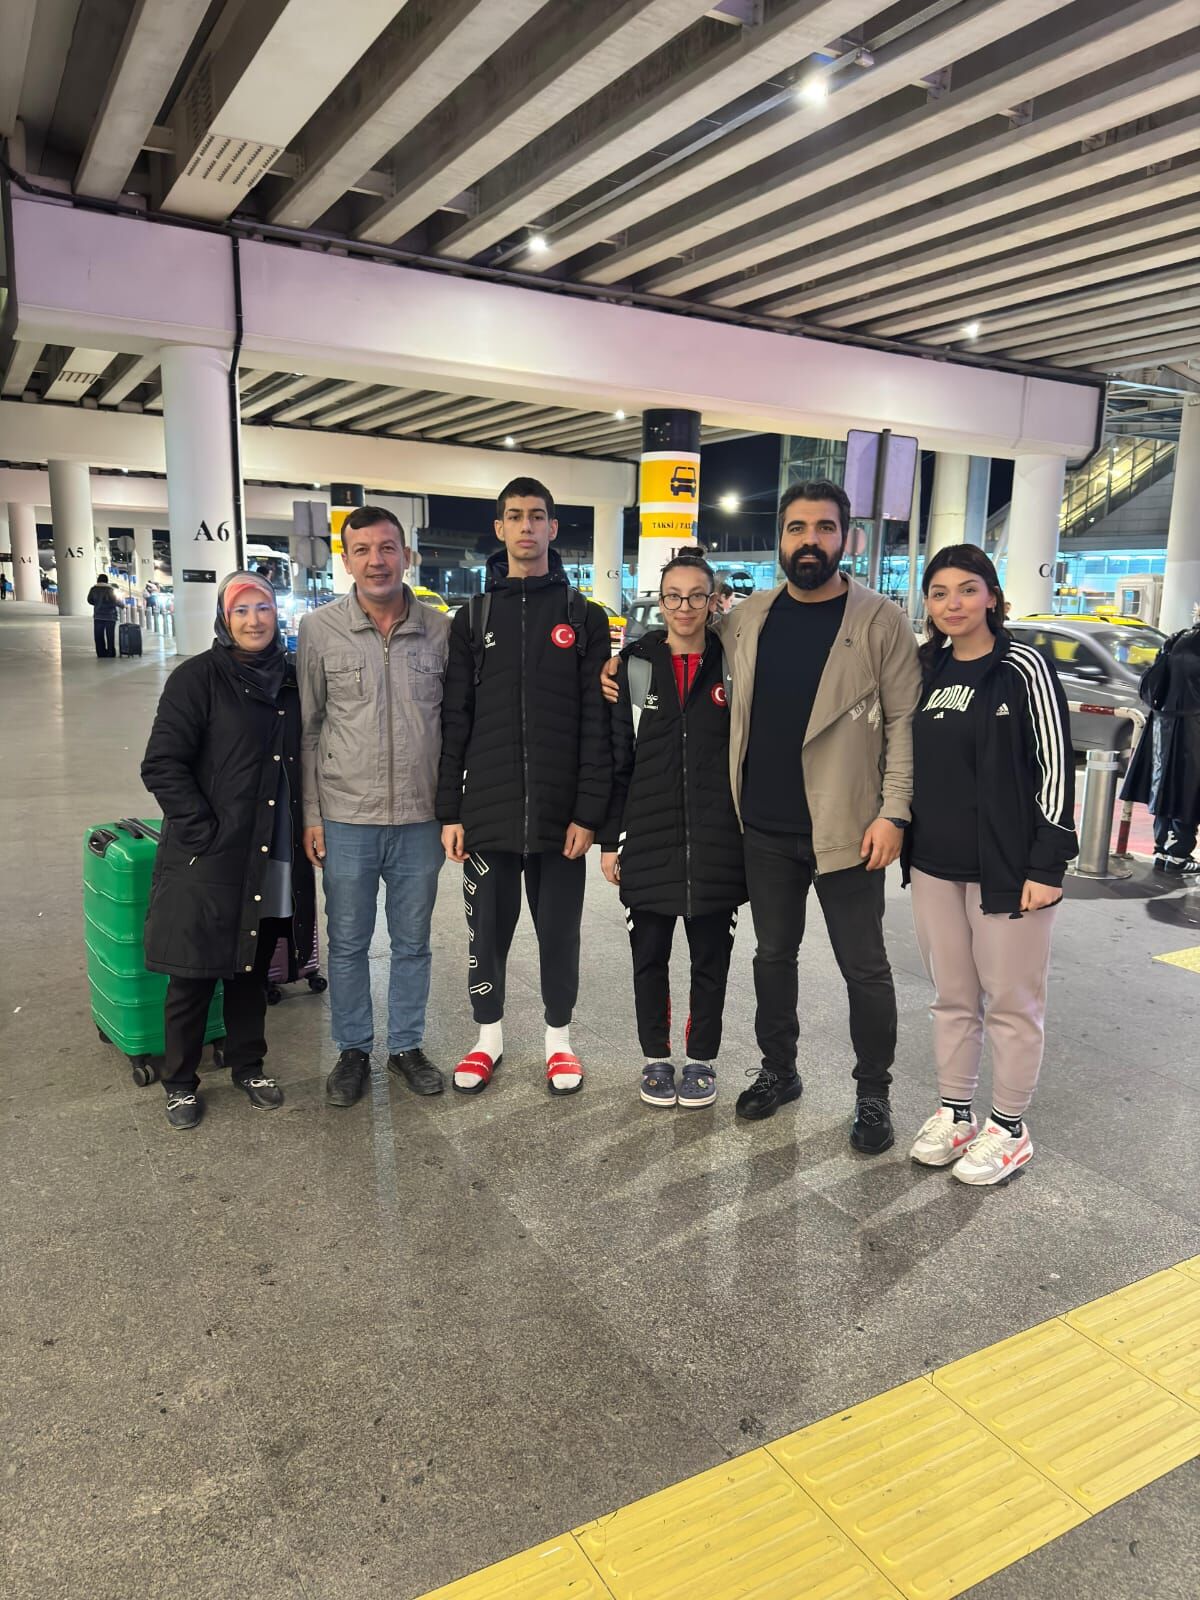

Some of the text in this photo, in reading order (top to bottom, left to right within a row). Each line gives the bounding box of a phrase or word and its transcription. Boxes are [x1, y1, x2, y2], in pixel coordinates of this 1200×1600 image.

[193, 520, 230, 542] A6
[64, 547, 84, 558] A5
[19, 556, 32, 564] A4
[607, 569, 620, 580] C5
